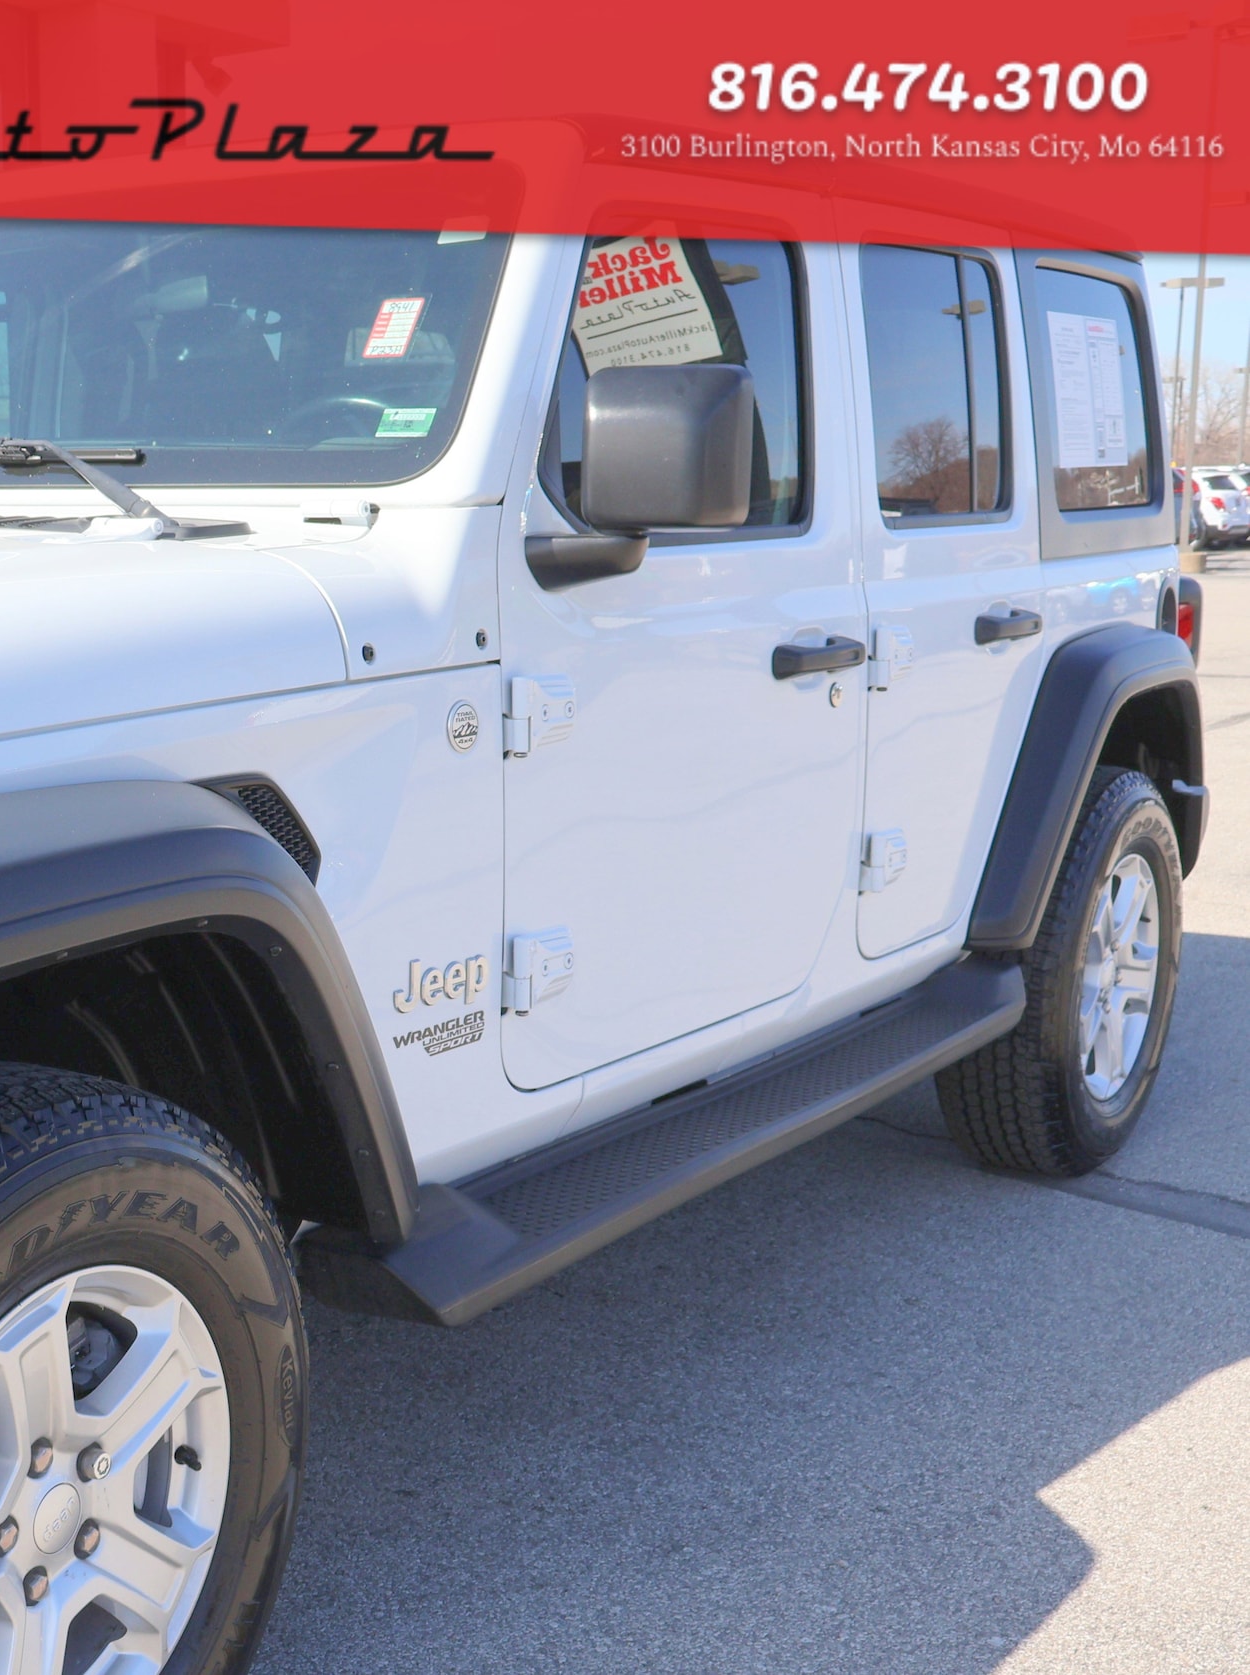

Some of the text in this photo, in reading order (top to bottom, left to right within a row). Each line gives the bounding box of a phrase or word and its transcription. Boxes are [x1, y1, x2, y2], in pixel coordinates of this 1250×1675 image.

[393, 953, 489, 1014] Jeep
[392, 1010, 485, 1049] WRANGLER
[422, 1021, 485, 1047] UNLIMITED
[424, 1030, 483, 1057] SPORT
[281, 1357, 295, 1430] Kevlar
[43, 1495, 75, 1543] Jeep
